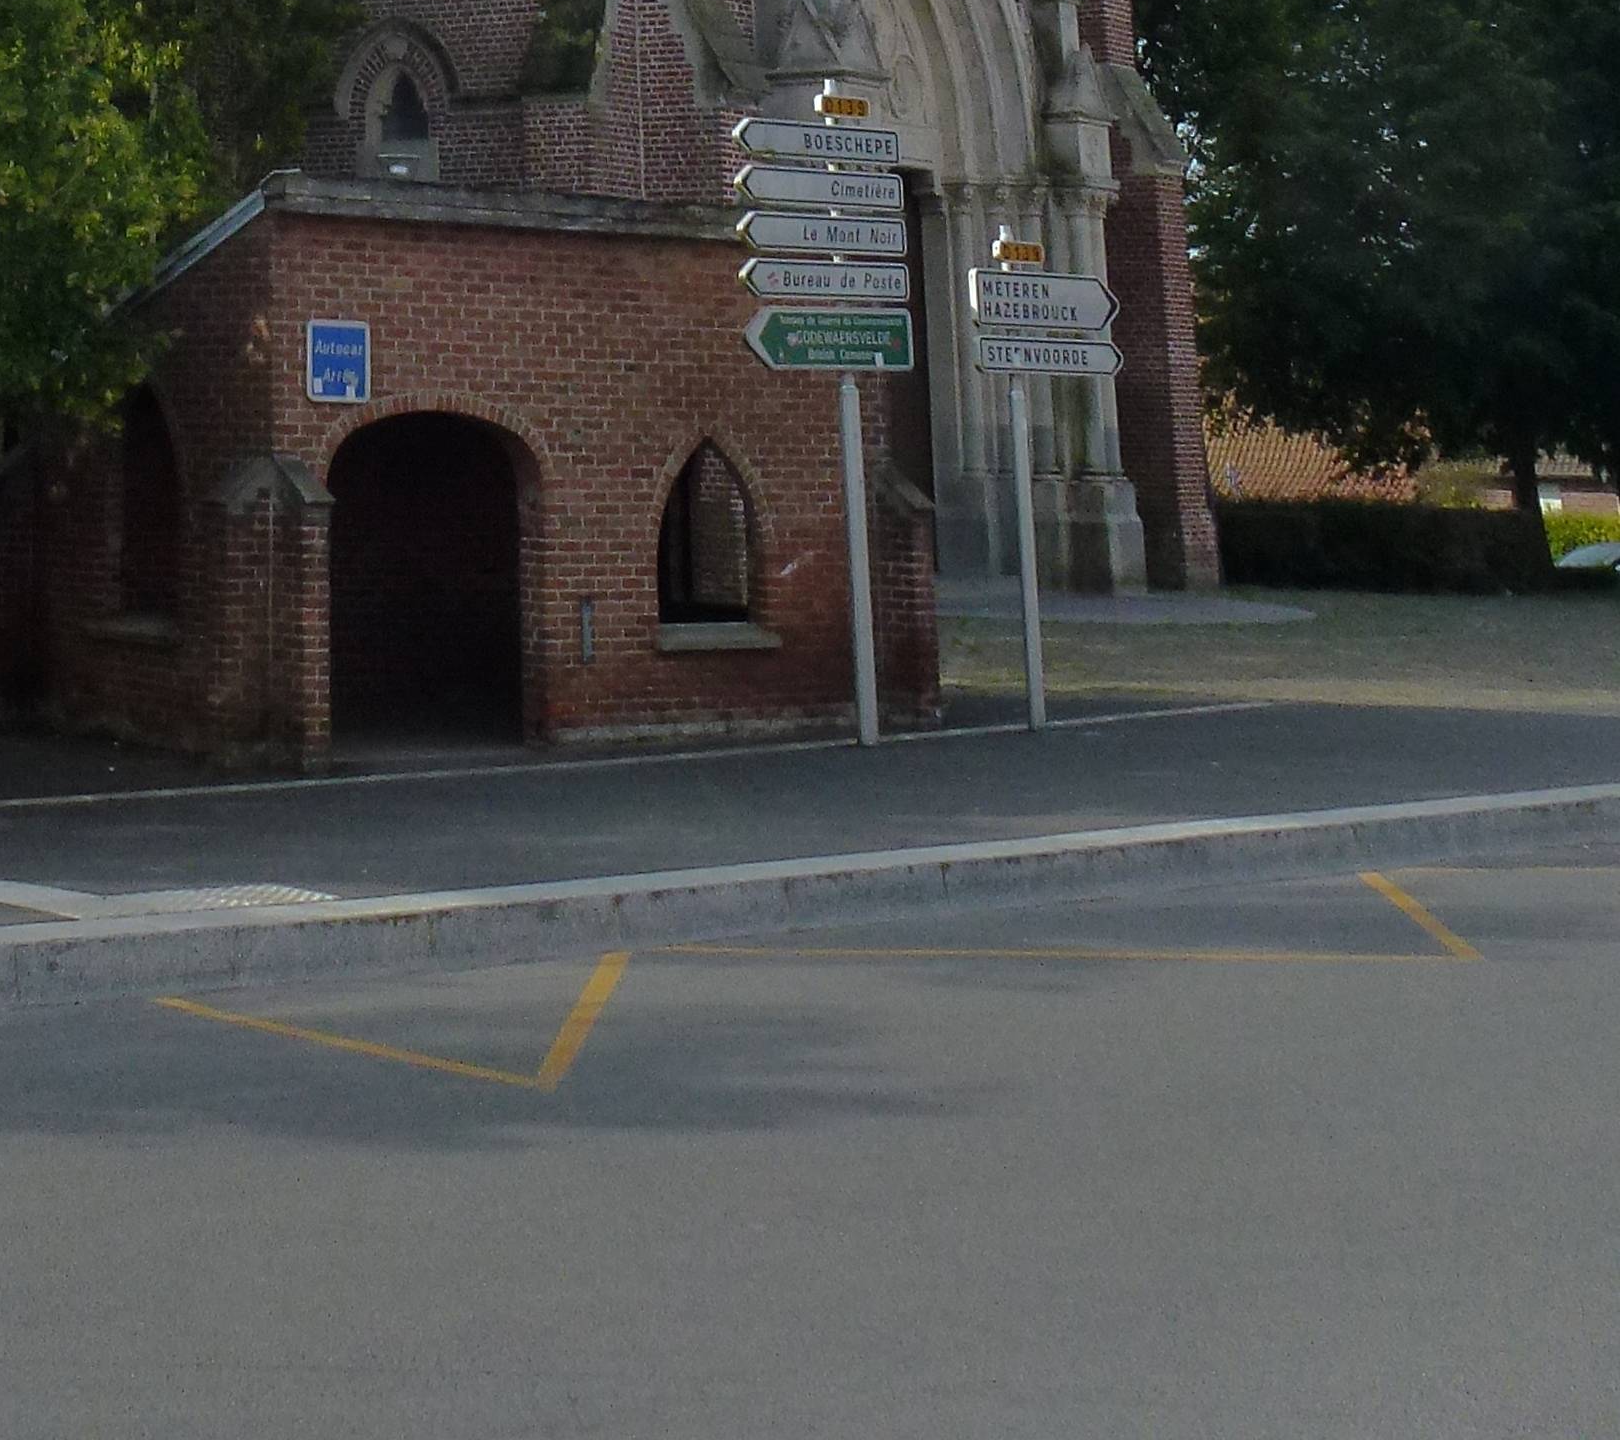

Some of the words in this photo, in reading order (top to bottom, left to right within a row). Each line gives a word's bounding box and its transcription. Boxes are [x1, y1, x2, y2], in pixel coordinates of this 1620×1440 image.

[823, 97, 867, 117] D139
[803, 132, 894, 155] BOESCHEPE
[830, 179, 896, 199] Cimetière
[803, 224, 818, 241] Le
[827, 225, 860, 243] Mont
[869, 227, 897, 243] Noir
[782, 271, 831, 288] Bureau
[840, 271, 856, 287] de
[864, 272, 902, 290] Poste
[982, 280, 1050, 299] METEREN
[983, 301, 1078, 322] HAZEBROUCK
[315, 339, 364, 356] Autocar
[987, 345, 1089, 366] STENVOORDE
